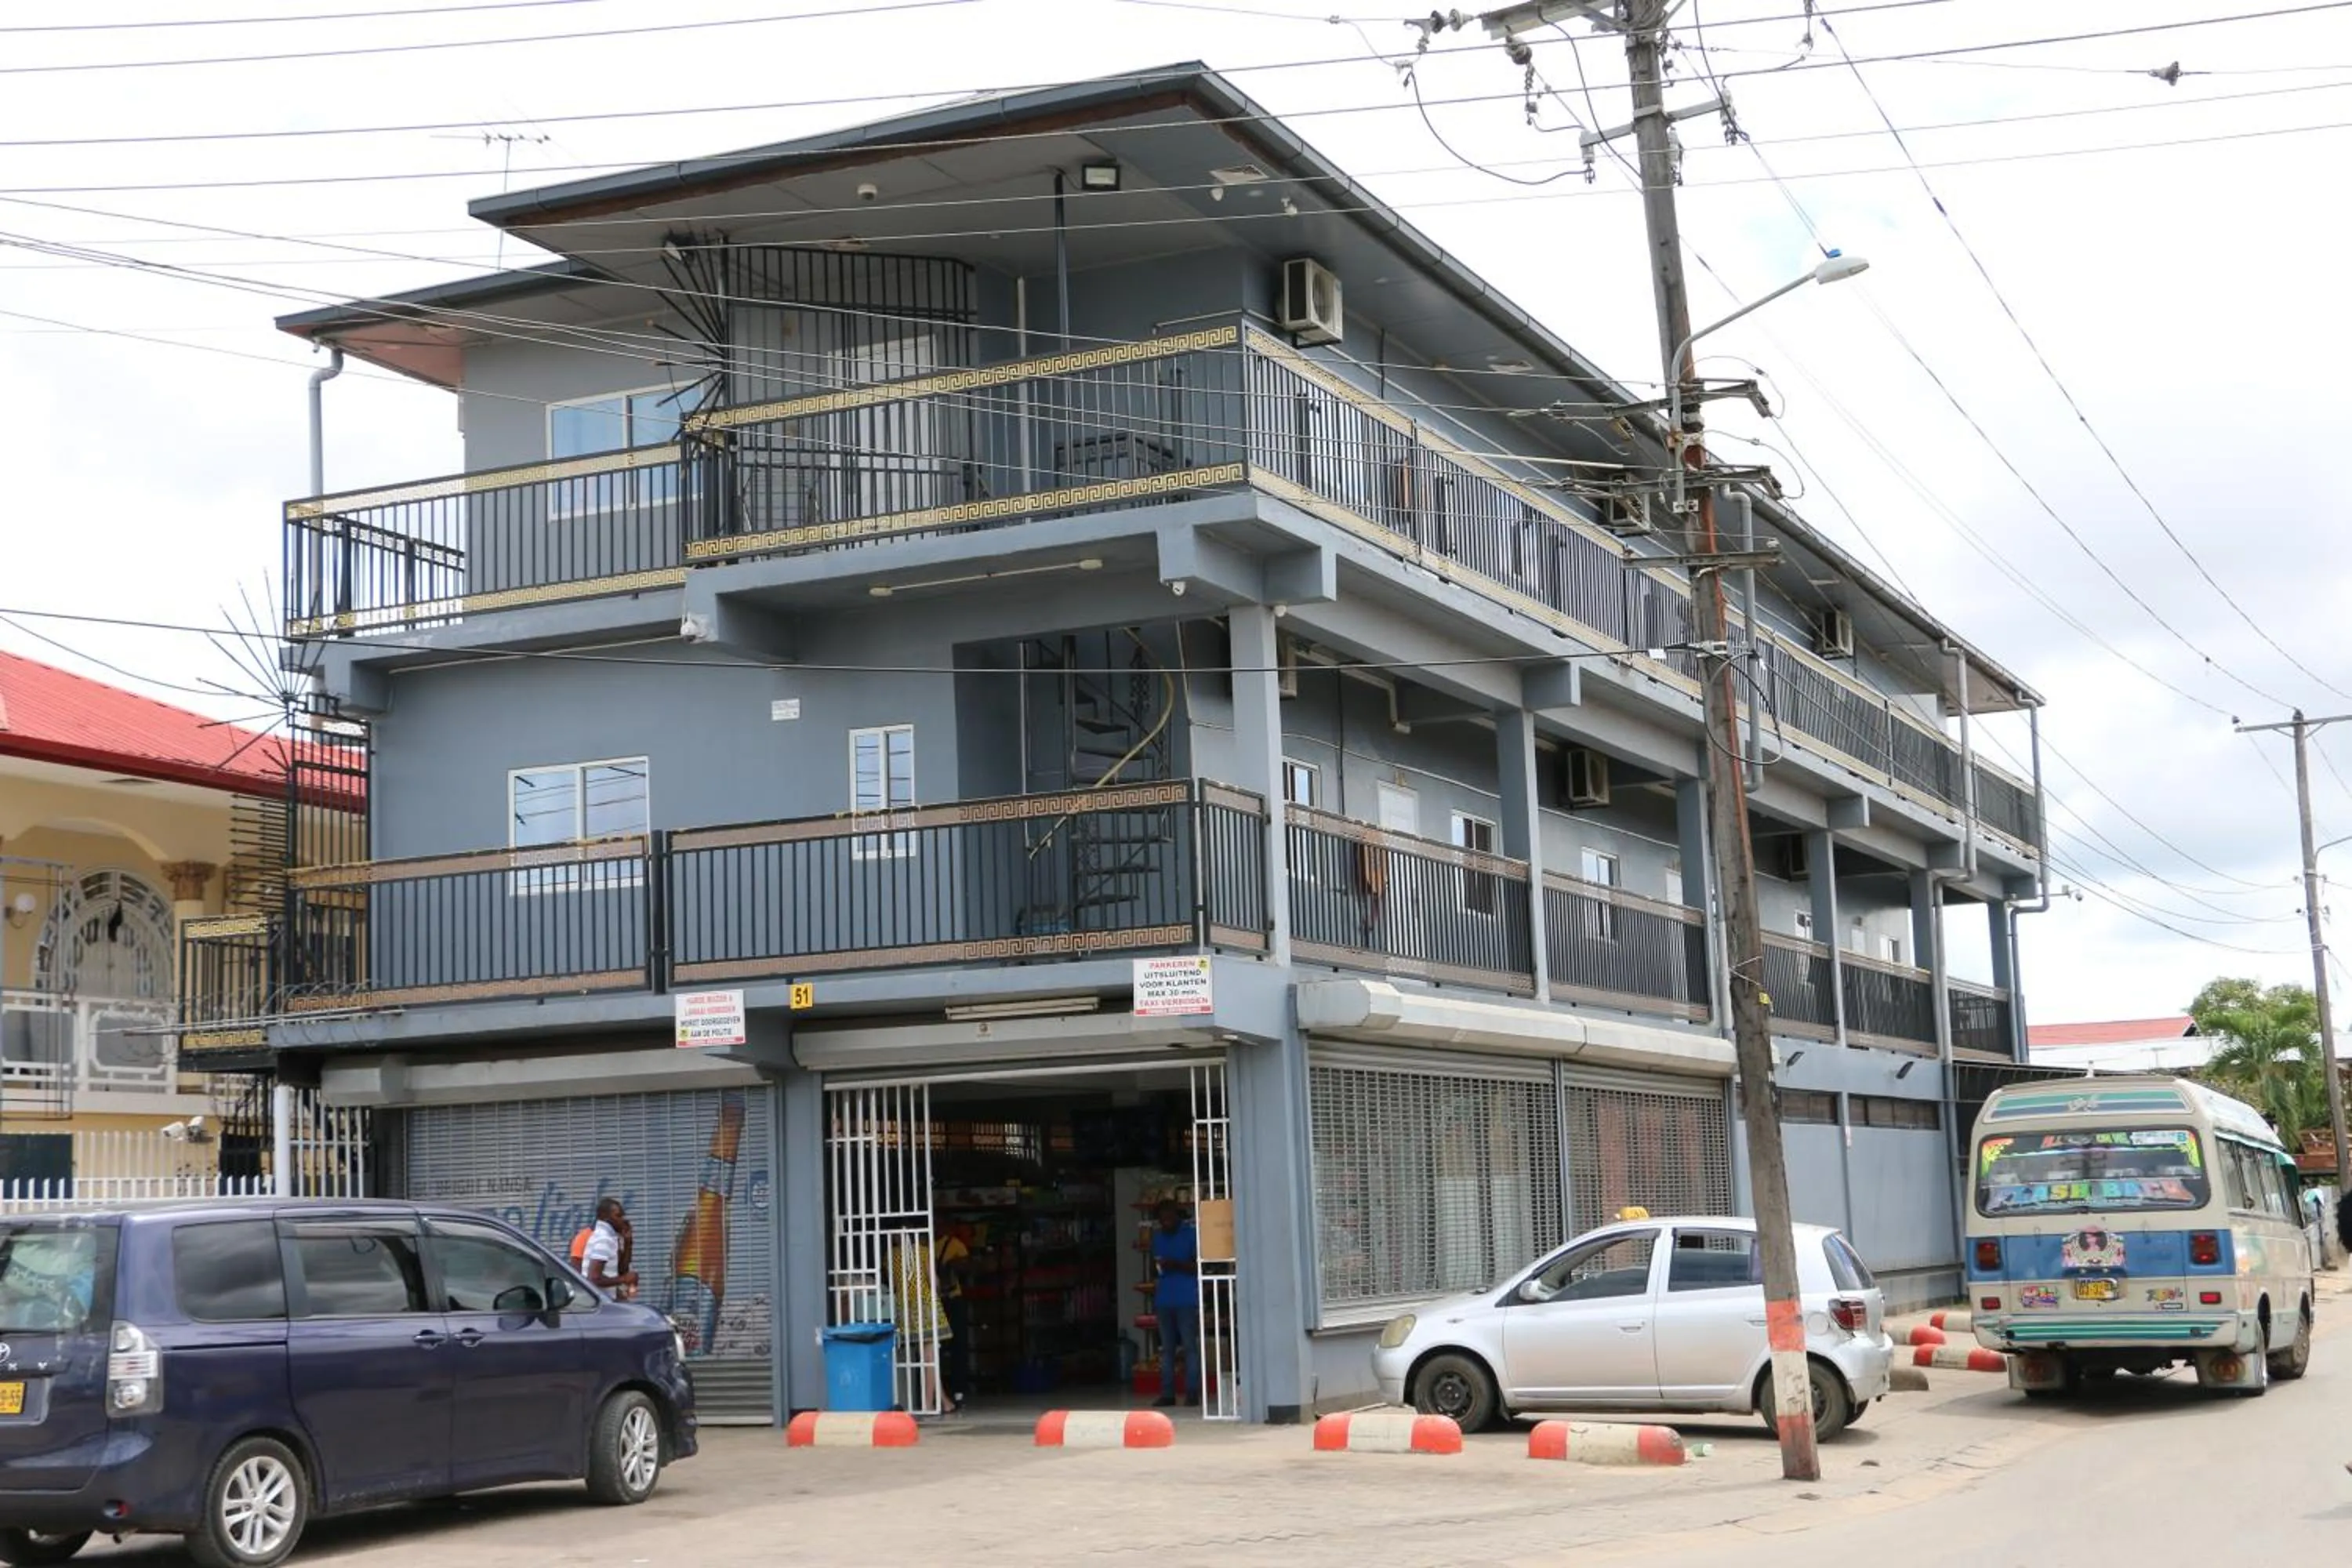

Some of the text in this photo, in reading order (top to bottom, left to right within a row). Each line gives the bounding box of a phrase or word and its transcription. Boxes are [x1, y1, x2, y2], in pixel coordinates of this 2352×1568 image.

[1149, 960, 1195, 969] PARKEREN
[1145, 969, 1202, 978] UITSLUITEND
[1167, 978, 1207, 987] KLANTEN
[796, 986, 808, 1004] 51
[1162, 996, 1208, 1005] VERBODEN
